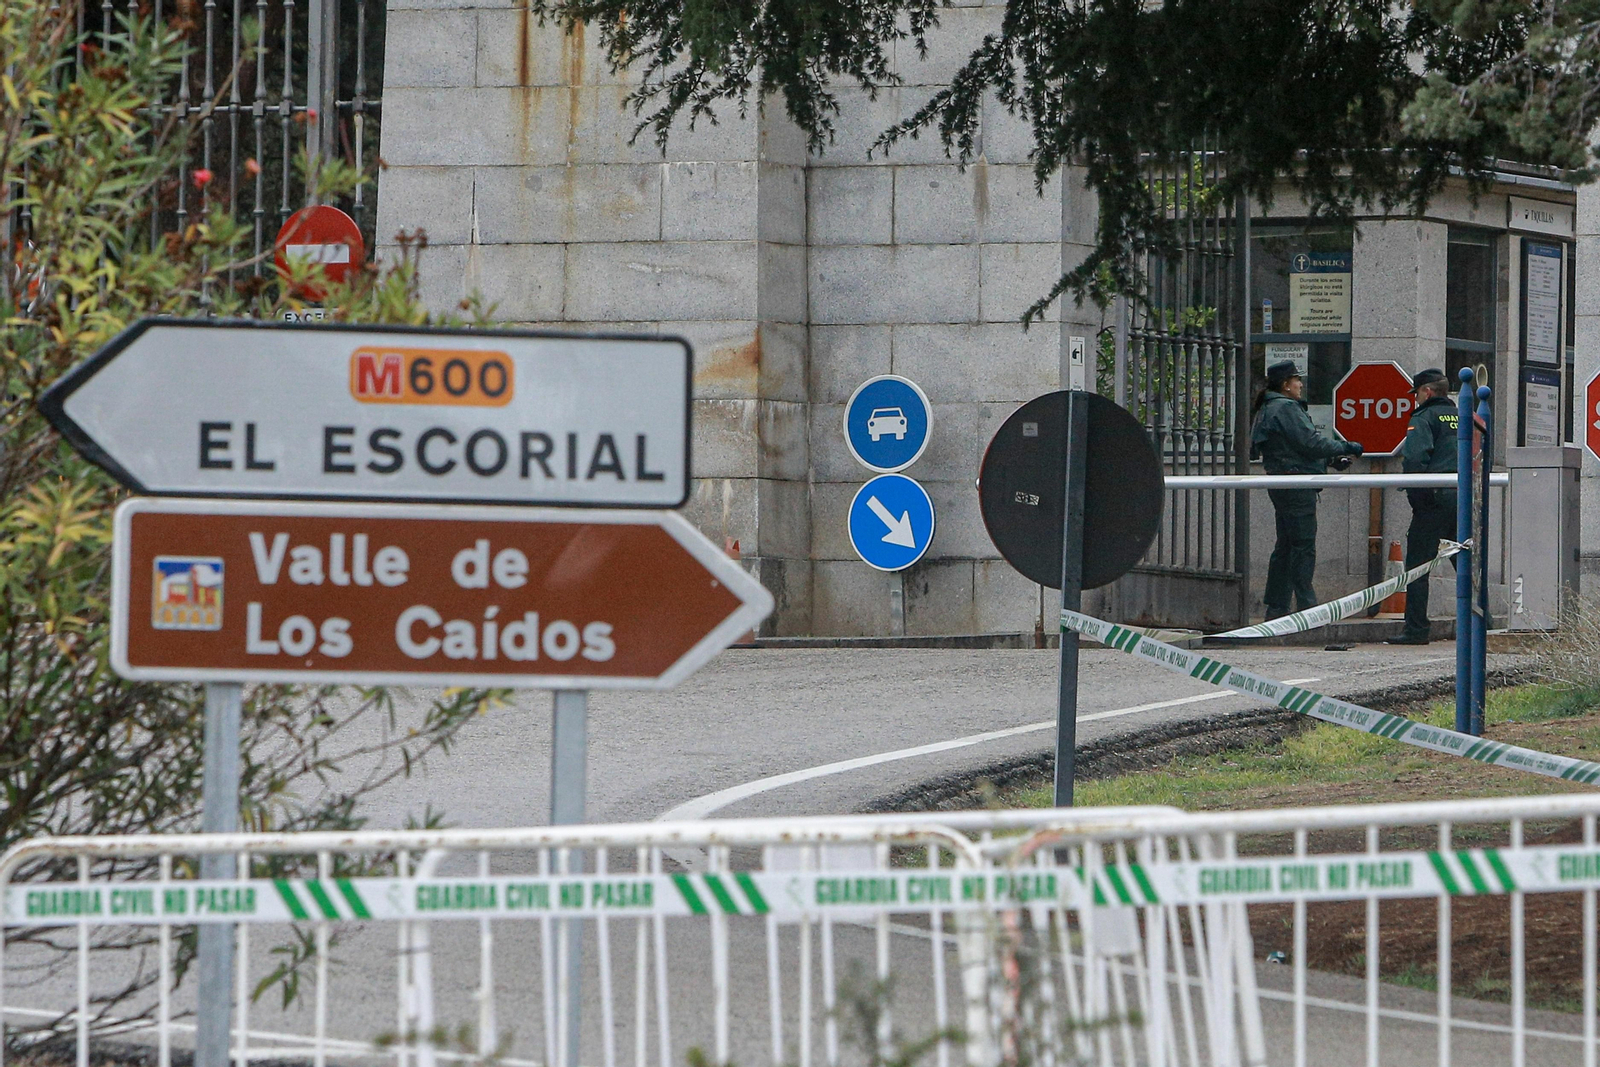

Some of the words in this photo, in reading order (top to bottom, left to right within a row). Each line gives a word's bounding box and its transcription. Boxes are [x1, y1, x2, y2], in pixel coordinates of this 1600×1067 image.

[1340, 398, 1411, 420] STOP
[199, 421, 275, 471] EL
[322, 425, 665, 482] ESCORIAL
[247, 532, 410, 588] Valle
[451, 539, 529, 590] de
[246, 602, 354, 658] Los
[395, 604, 617, 663] Caídos
[1140, 641, 1158, 658] GUARDIA
[1156, 646, 1167, 662] CIVIL
[1168, 651, 1176, 664] NO
[1176, 653, 1188, 669] PASAR
[1228, 672, 1246, 688] GUARDIA
[1257, 681, 1266, 696] NO
[1264, 683, 1278, 699] PASAR
[1318, 700, 1336, 716] GUARDIA
[1348, 709, 1356, 722] NO
[1354, 711, 1370, 726] PASAR
[816, 878, 897, 904] GUARDIA
[907, 876, 951, 903] CIVIL
[1200, 868, 1272, 894] GUARDIA
[1328, 863, 1348, 889] NO
[1356, 860, 1412, 888] PASAR
[26, 890, 102, 916] GUARDIA
[110, 888, 154, 915] CIVIL
[162, 888, 188, 914] NO
[195, 886, 256, 914] PASAR
[416, 883, 496, 910] GUARDIA
[506, 882, 550, 910] CIVIL
[559, 882, 584, 908] NO
[592, 882, 654, 909] PASAR
